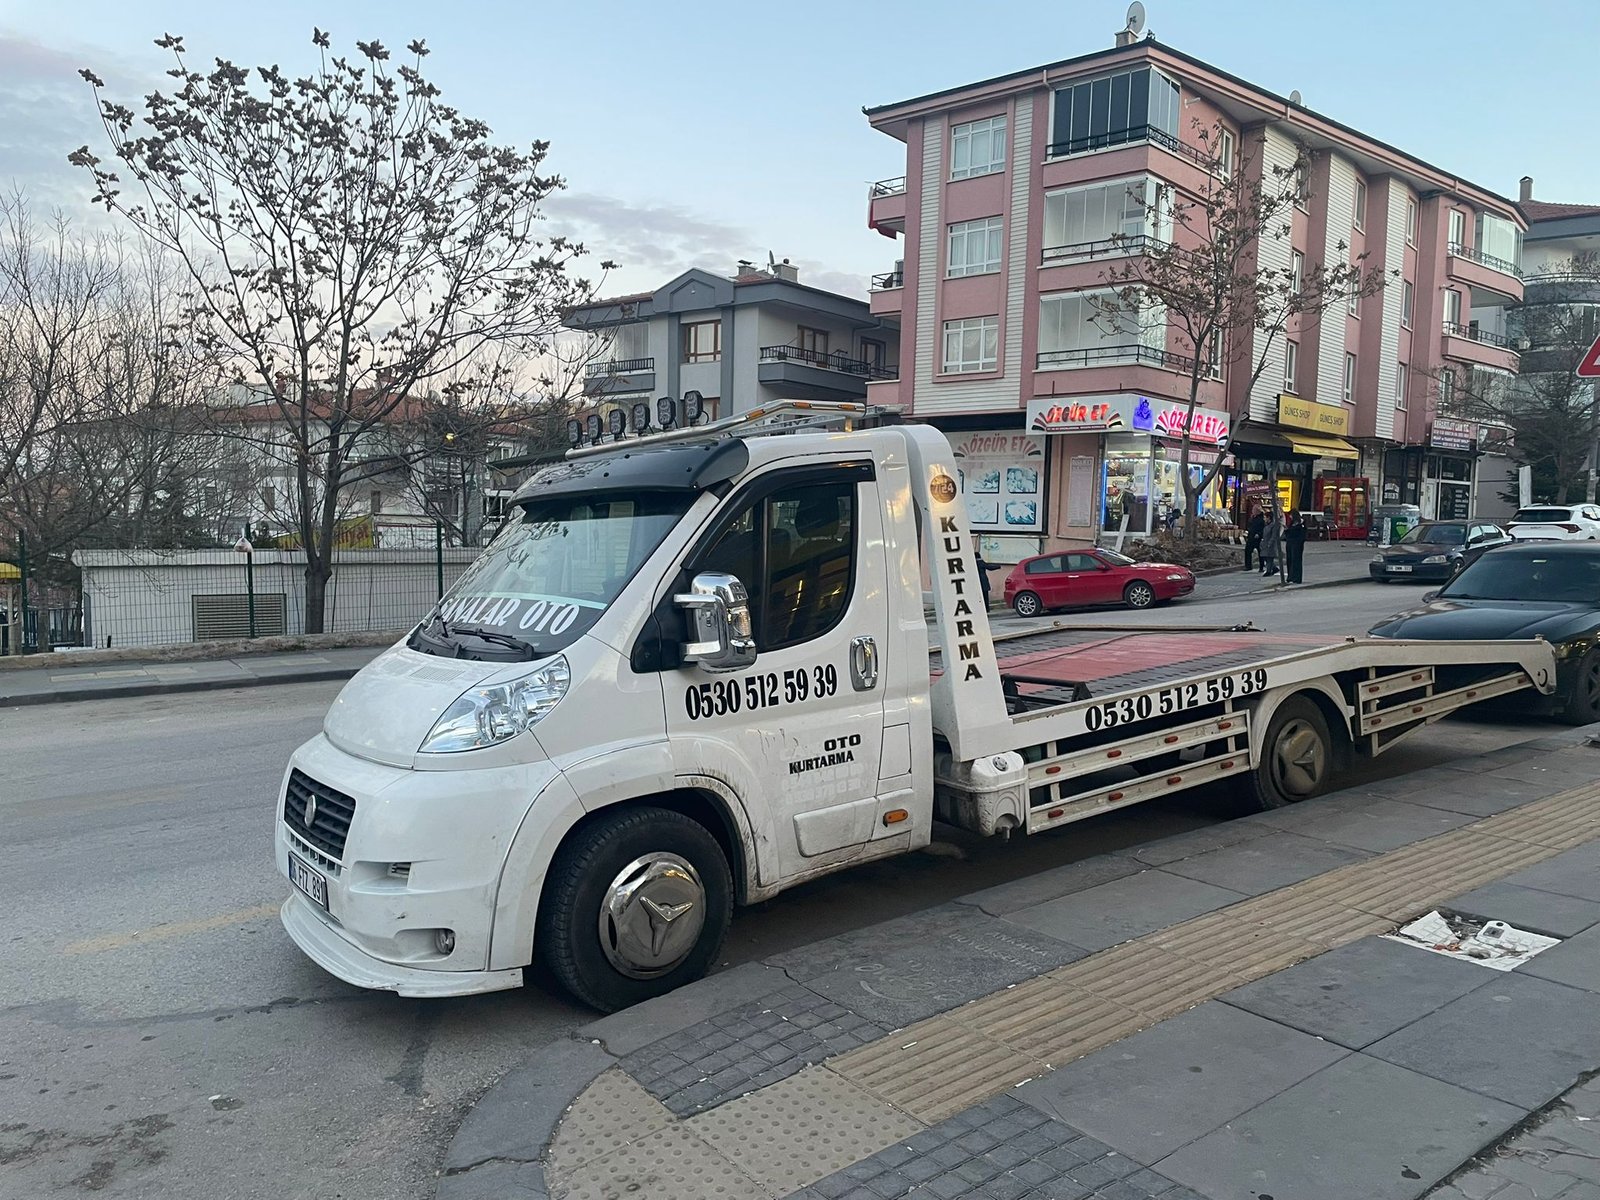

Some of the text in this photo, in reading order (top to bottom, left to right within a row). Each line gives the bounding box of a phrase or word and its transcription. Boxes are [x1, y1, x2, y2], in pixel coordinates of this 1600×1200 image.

[1047, 402, 1109, 424] ÖZGÜR ET
[1299, 409, 1311, 419] SHOP
[1205, 416, 1218, 435] ET
[970, 432, 1027, 454] ÖZGÜR ET
[939, 515, 983, 682] KURTARMA
[519, 599, 580, 636] OTO
[685, 663, 837, 720] 0530 512 59 39
[1085, 668, 1267, 731] 0530 512 59 39
[824, 733, 861, 751] OTO
[789, 750, 854, 774] KURTARMA
